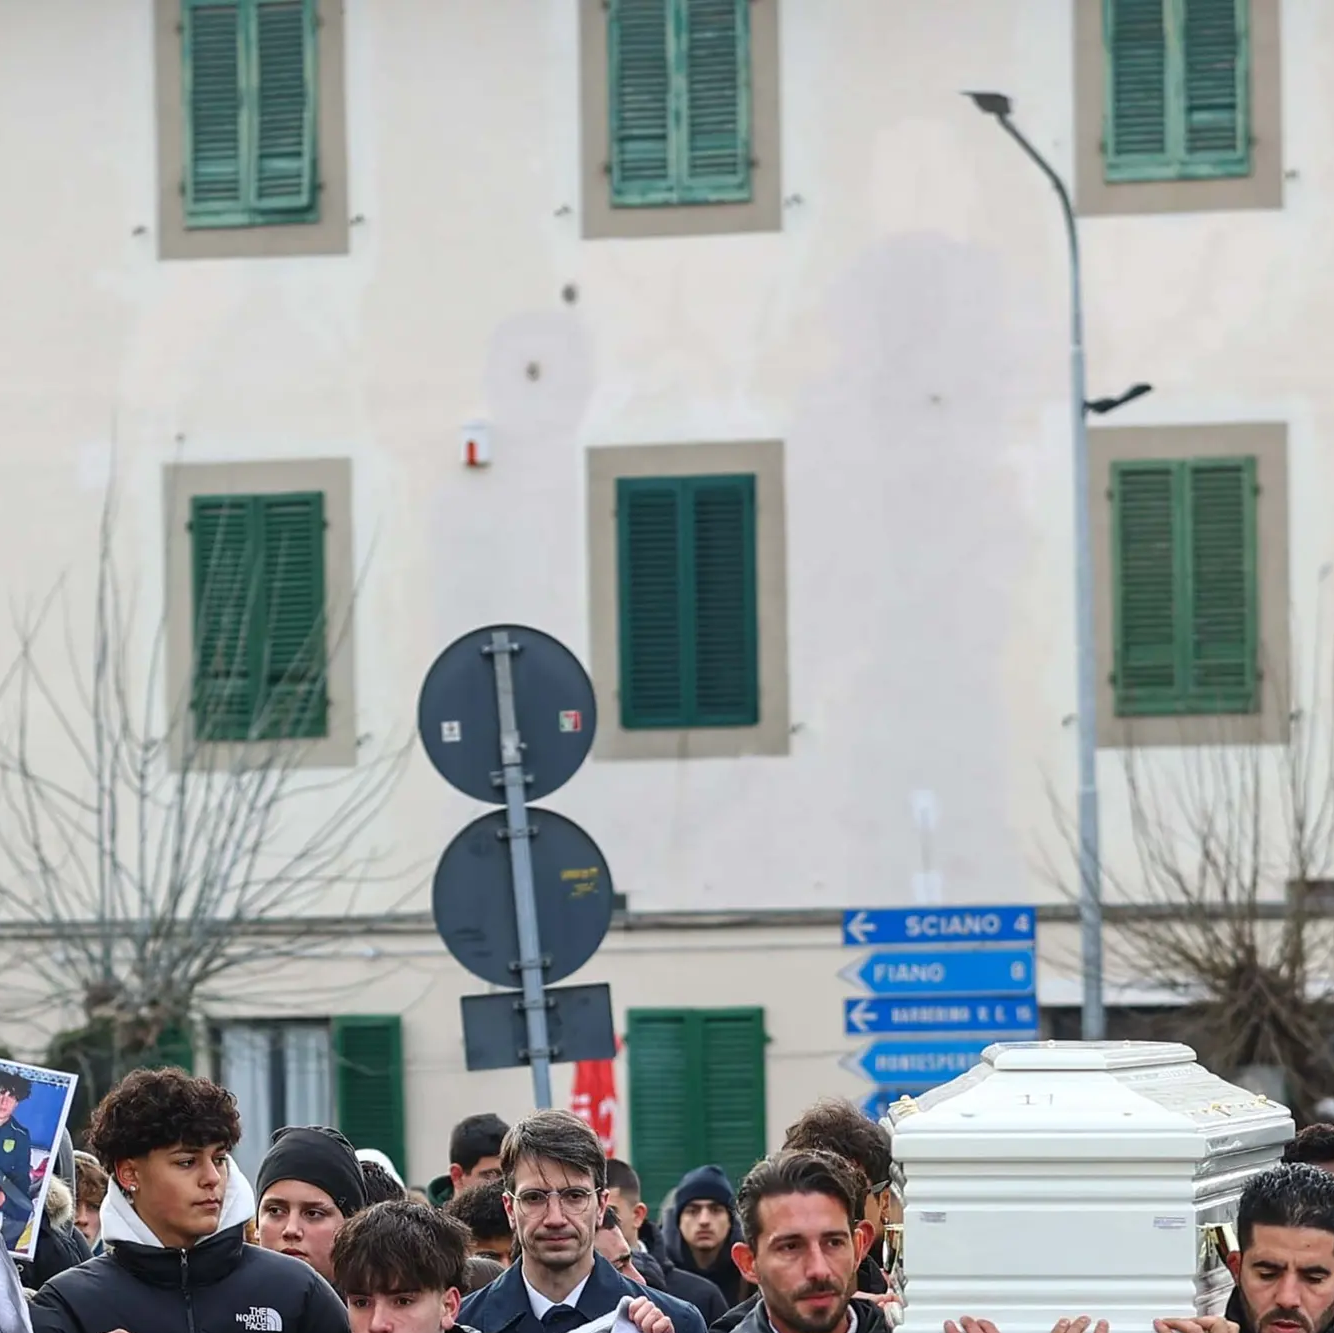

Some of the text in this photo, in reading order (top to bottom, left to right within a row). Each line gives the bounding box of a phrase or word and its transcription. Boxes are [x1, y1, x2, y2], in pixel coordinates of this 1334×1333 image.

[905, 912, 1030, 937] SCIANO 4
[873, 962, 946, 983] FIANO
[249, 1306, 267, 1316] THE
[235, 1313, 267, 1323] NORTH
[245, 1321, 267, 1331] FACE
